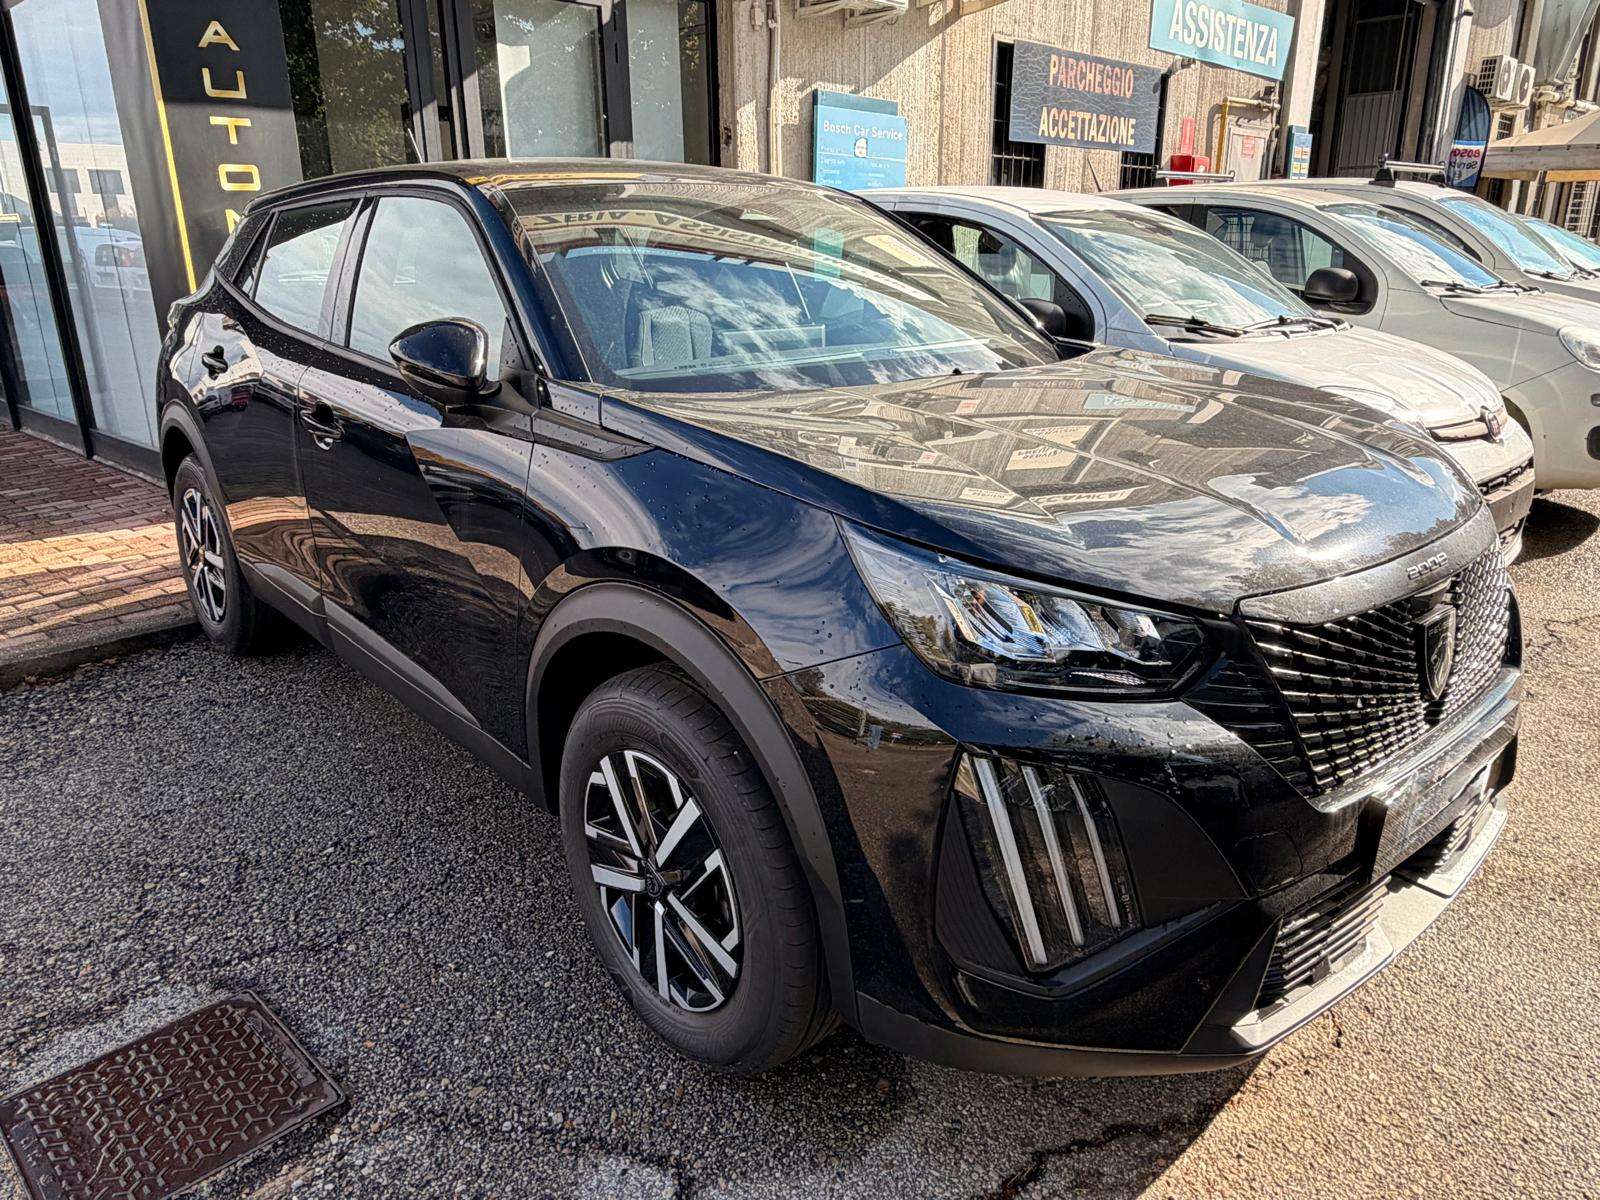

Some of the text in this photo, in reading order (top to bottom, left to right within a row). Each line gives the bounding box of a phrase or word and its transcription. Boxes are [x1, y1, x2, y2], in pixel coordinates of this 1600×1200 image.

[1168, 0, 1278, 67] ASSISTENZA
[1049, 54, 1134, 99] PARCHEGGIO
[823, 121, 903, 141] Bosch Car Service
[1037, 106, 1137, 146] ACCETTAZIONE
[1406, 552, 1447, 580] 2008
